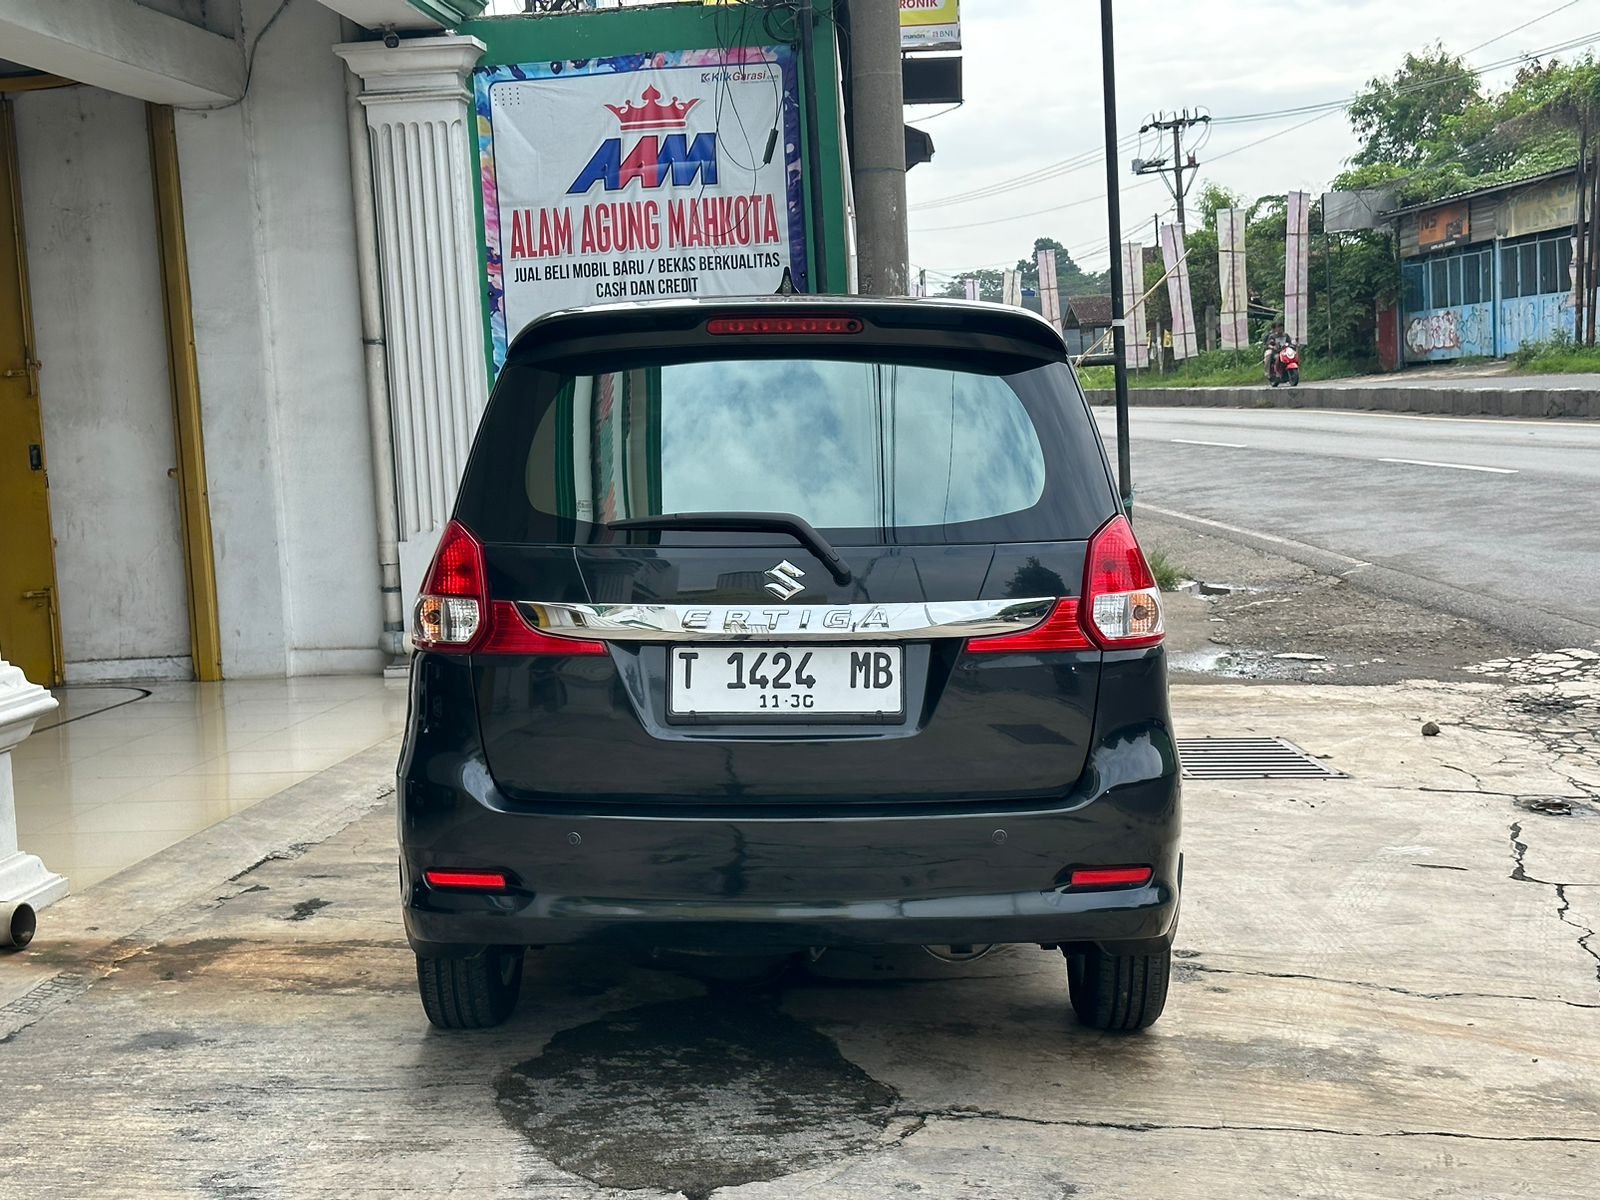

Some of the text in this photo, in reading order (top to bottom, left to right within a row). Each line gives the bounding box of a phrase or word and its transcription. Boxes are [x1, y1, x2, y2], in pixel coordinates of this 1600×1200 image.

[566, 132, 718, 194] AAM
[511, 194, 779, 258] ALAM AGUNG MAHKOTA
[514, 252, 780, 282] JUAL BELI MOBIL BARU / BEKAS BERKUALITAS
[596, 277, 698, 298] CASH DAN CREDIT
[681, 609, 890, 630] ERTIGA
[678, 652, 893, 690] T 1424 MB
